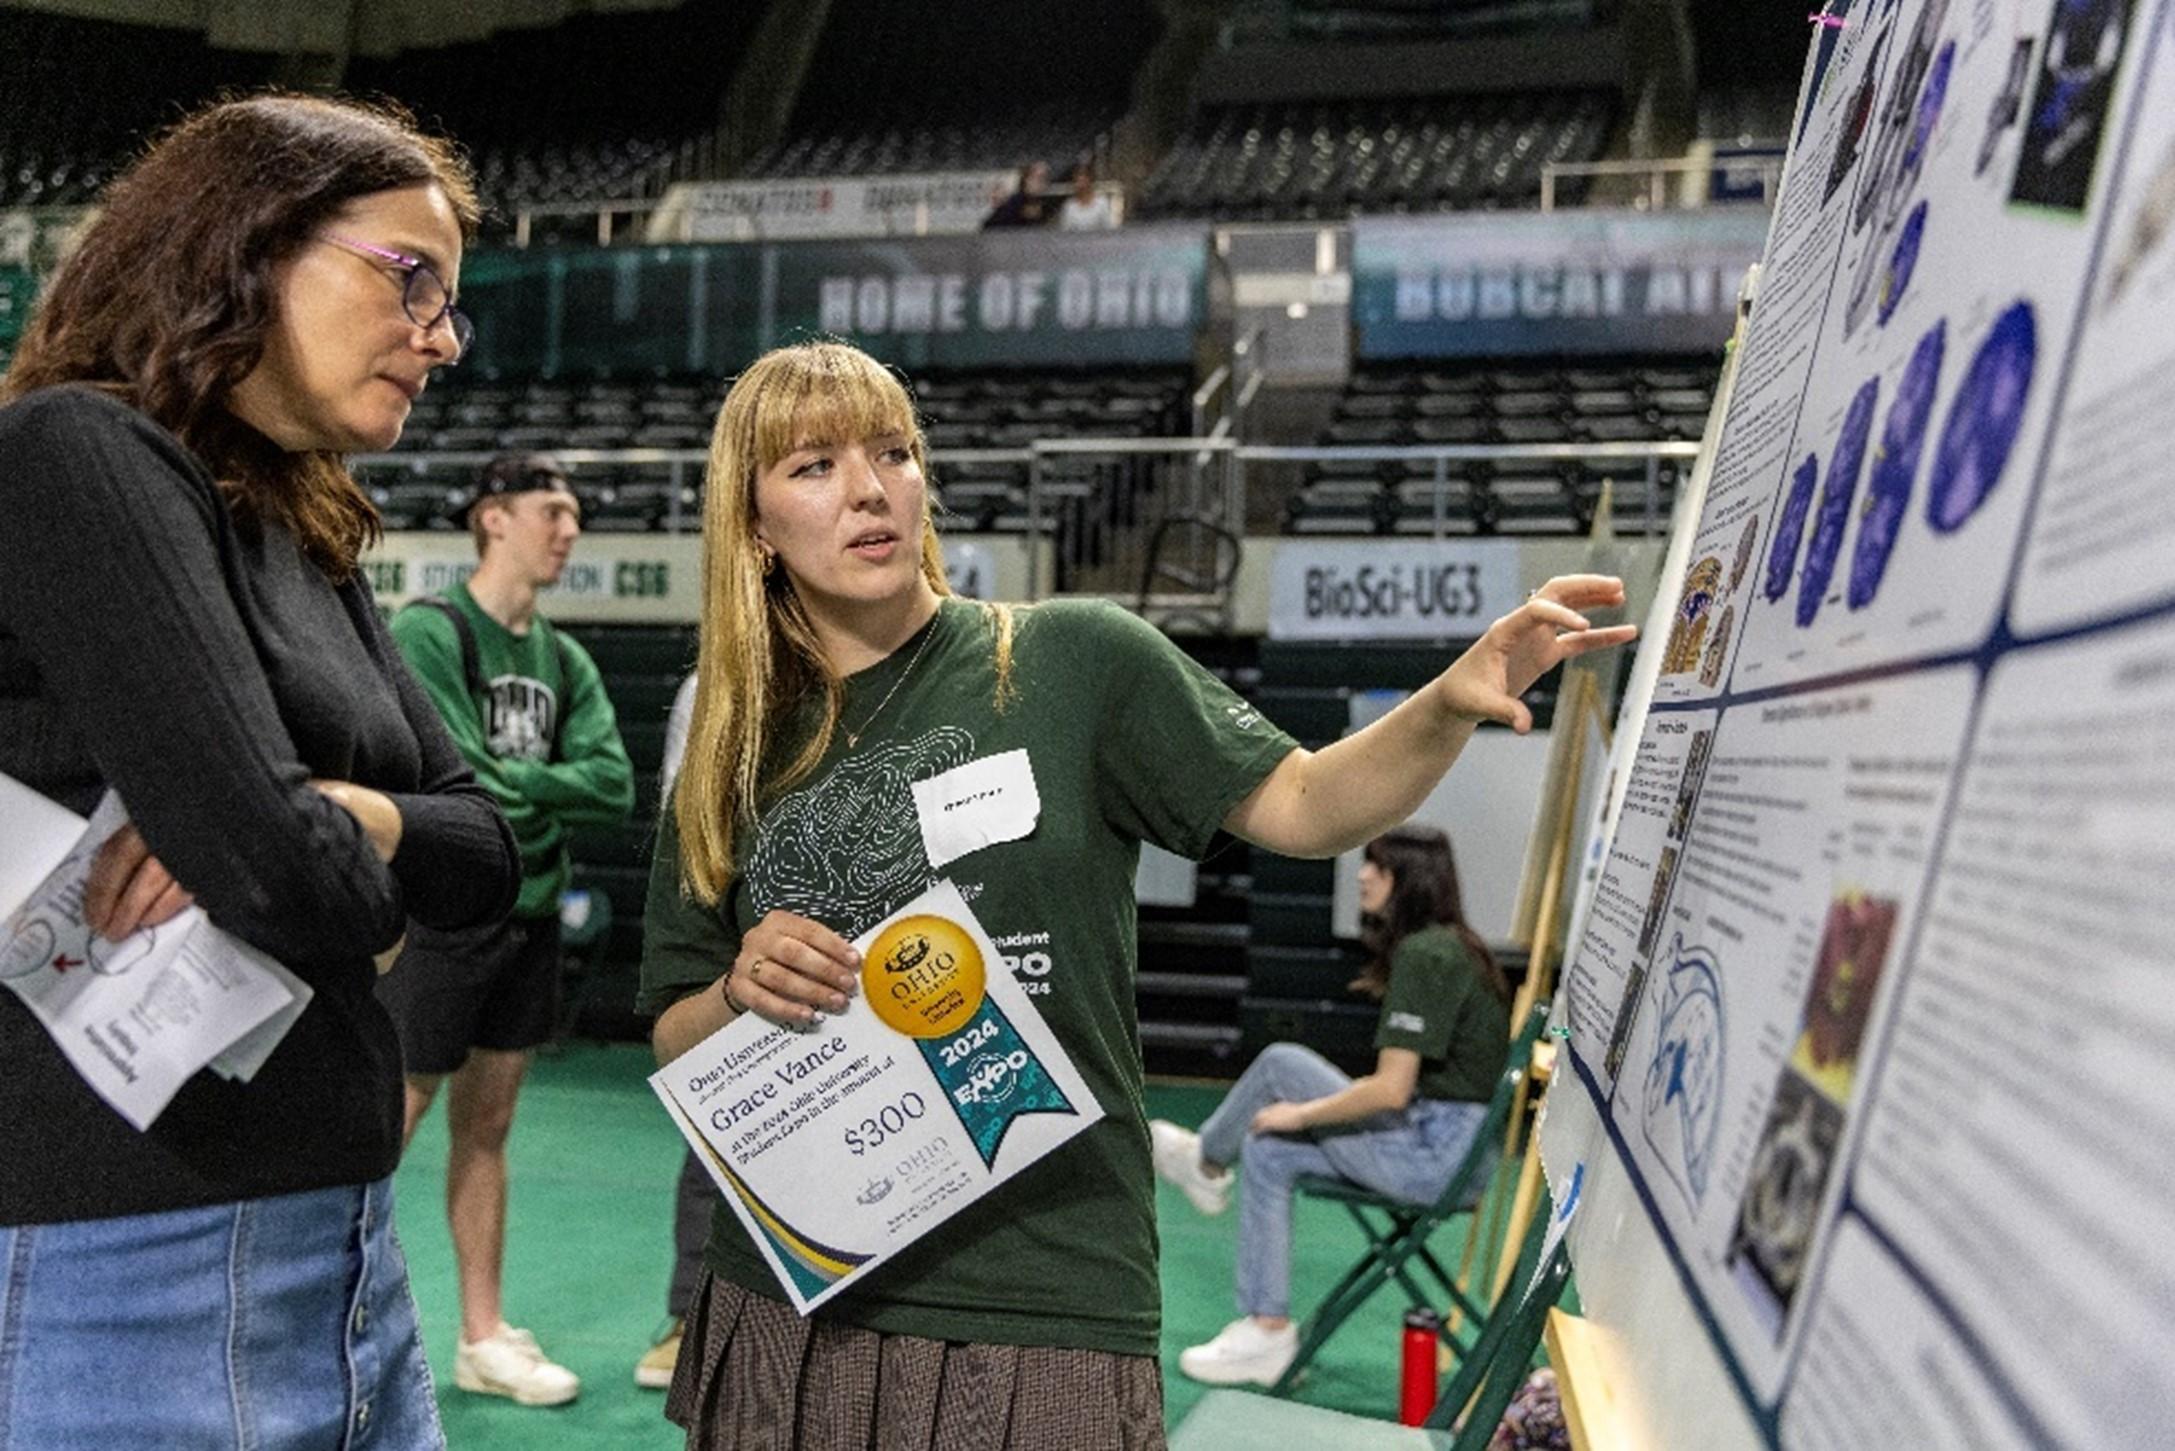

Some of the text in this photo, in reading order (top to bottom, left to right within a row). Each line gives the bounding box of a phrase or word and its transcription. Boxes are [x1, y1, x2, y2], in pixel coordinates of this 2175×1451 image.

[818, 269, 1191, 333] HOME OF OHIO
[1304, 566, 1484, 619] BioSci-UG3
[890, 951, 955, 1001] OHIO
[1000, 951, 1053, 977] PO
[940, 1020, 998, 1066] 2024
[711, 1083, 778, 1131] Grace
[775, 1037, 846, 1085] Vance
[954, 1051, 1027, 1105] EXPO
[845, 1093, 925, 1155] $300
